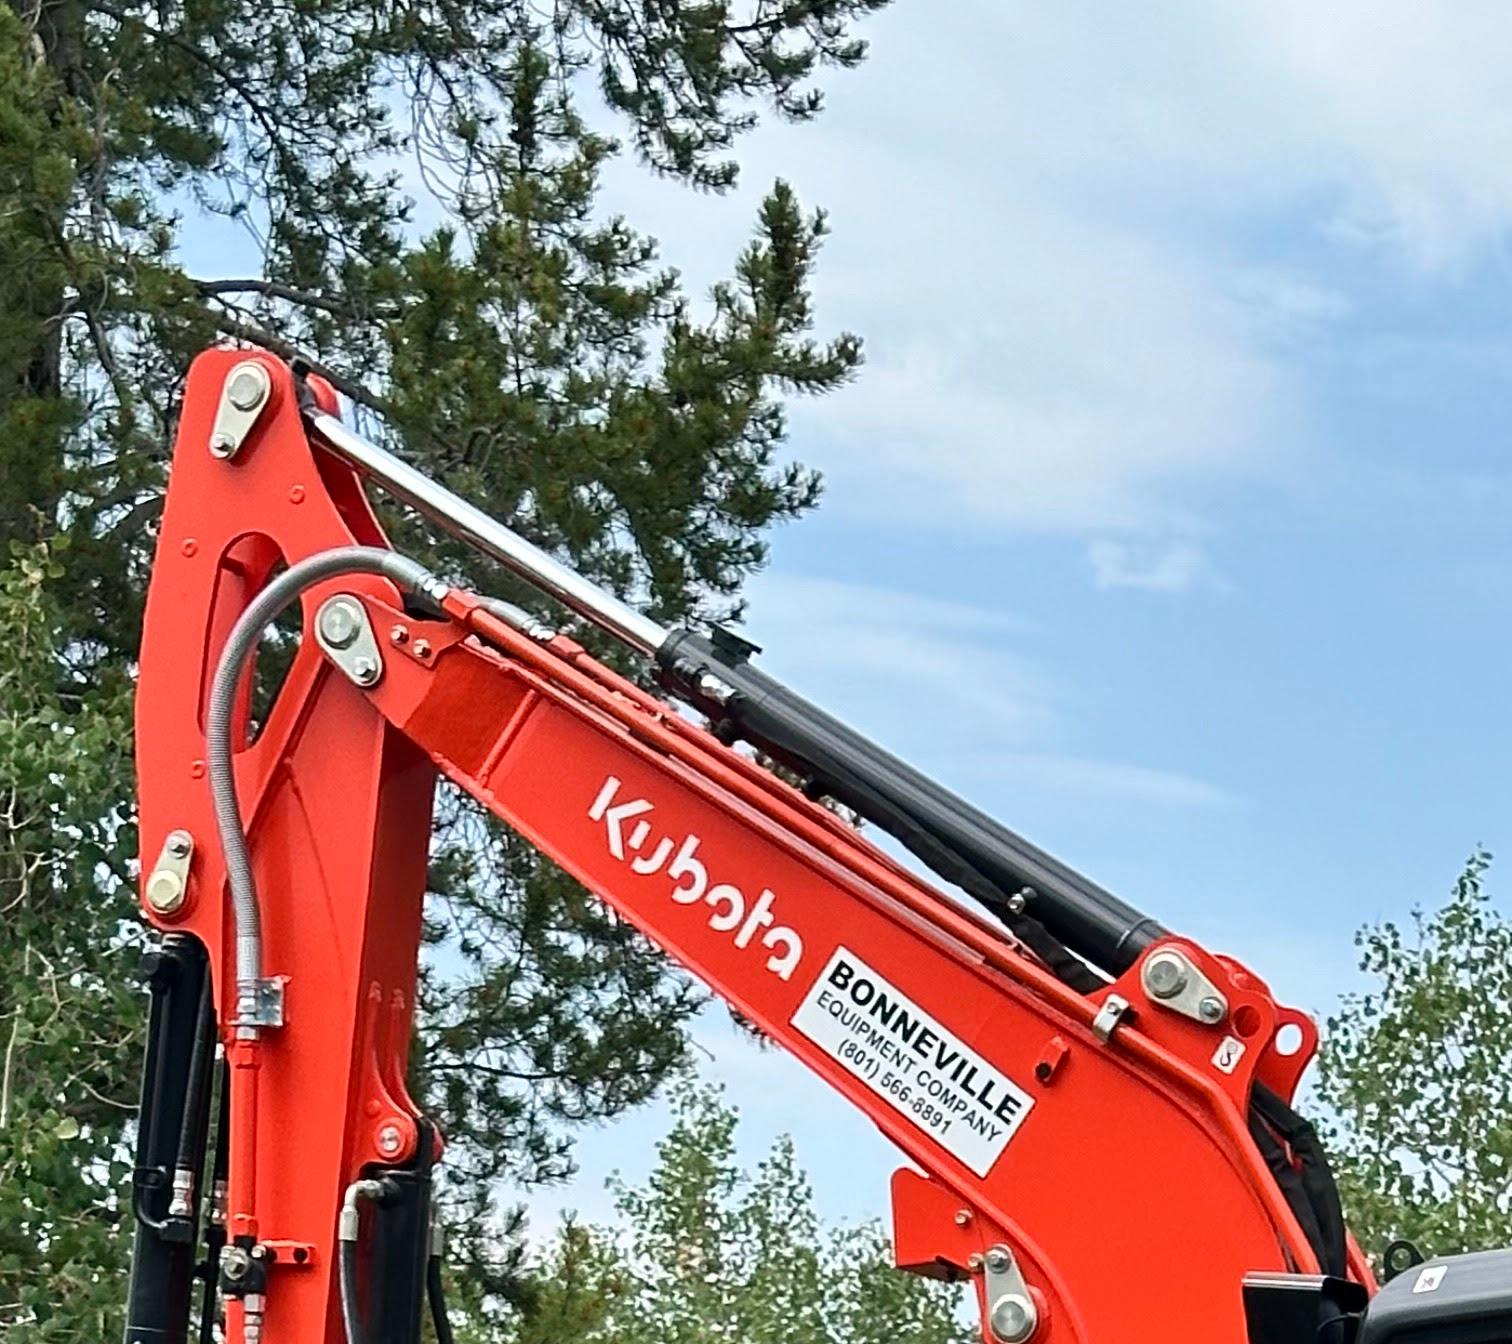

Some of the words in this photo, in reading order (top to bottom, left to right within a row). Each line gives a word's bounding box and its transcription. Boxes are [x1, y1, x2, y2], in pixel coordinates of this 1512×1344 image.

[588, 775, 803, 981] Kubota
[816, 990, 917, 1074] EQUIPMENT
[916, 1070, 1002, 1143] COMPANY
[828, 960, 1022, 1125] BONNEVILLE
[837, 1039, 881, 1080] (801)
